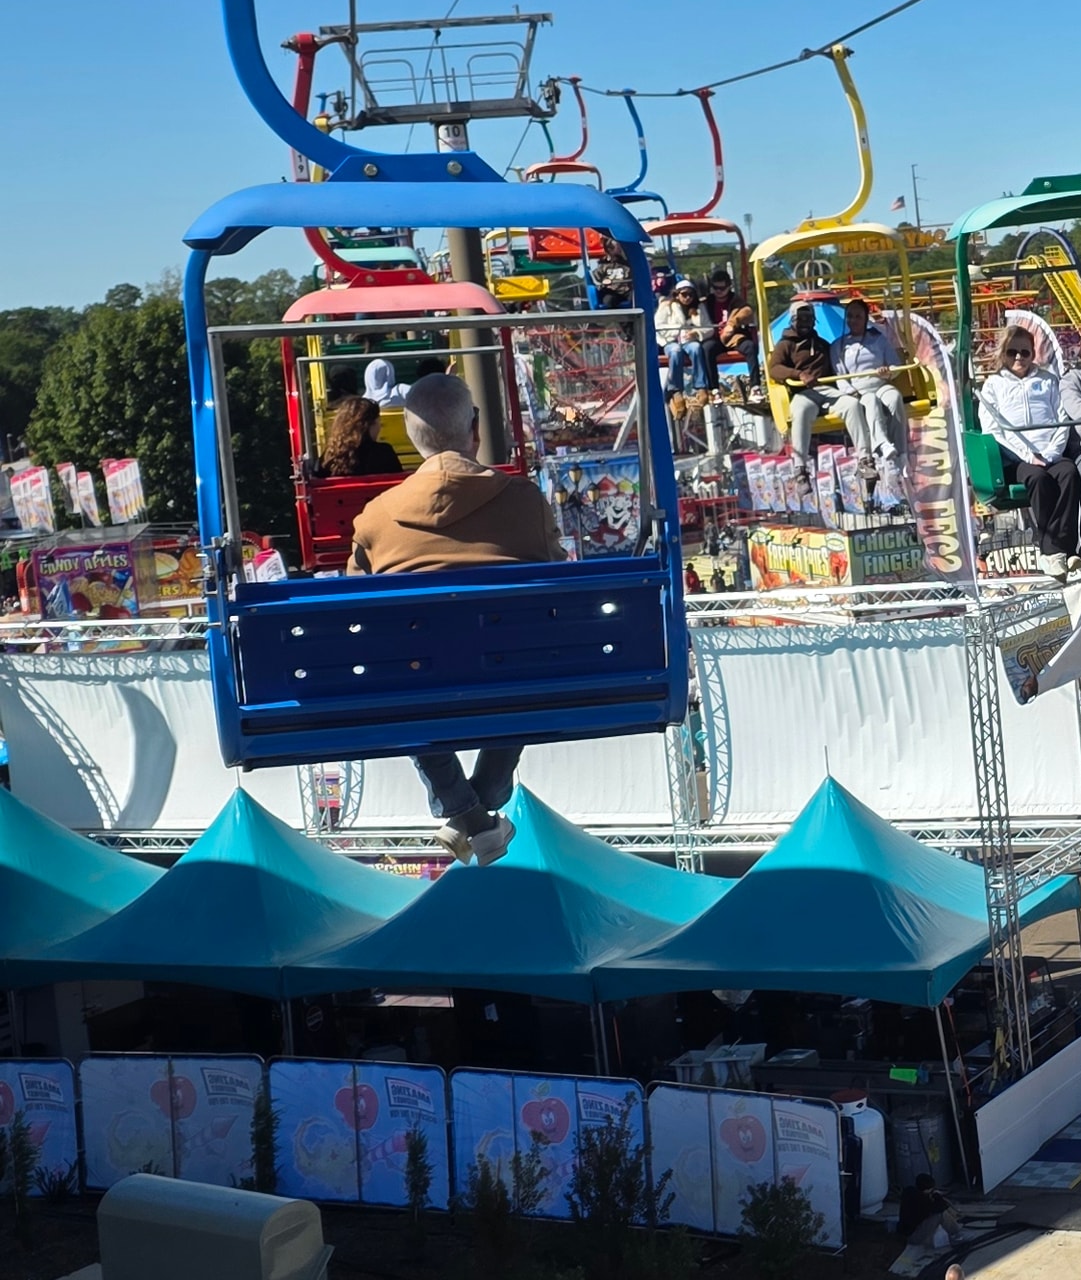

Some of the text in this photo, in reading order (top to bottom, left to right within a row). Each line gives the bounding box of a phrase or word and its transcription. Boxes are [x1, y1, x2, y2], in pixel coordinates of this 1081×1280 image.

[39, 553, 129, 576] CANDY APPLES
[864, 549, 922, 575] FINGER
